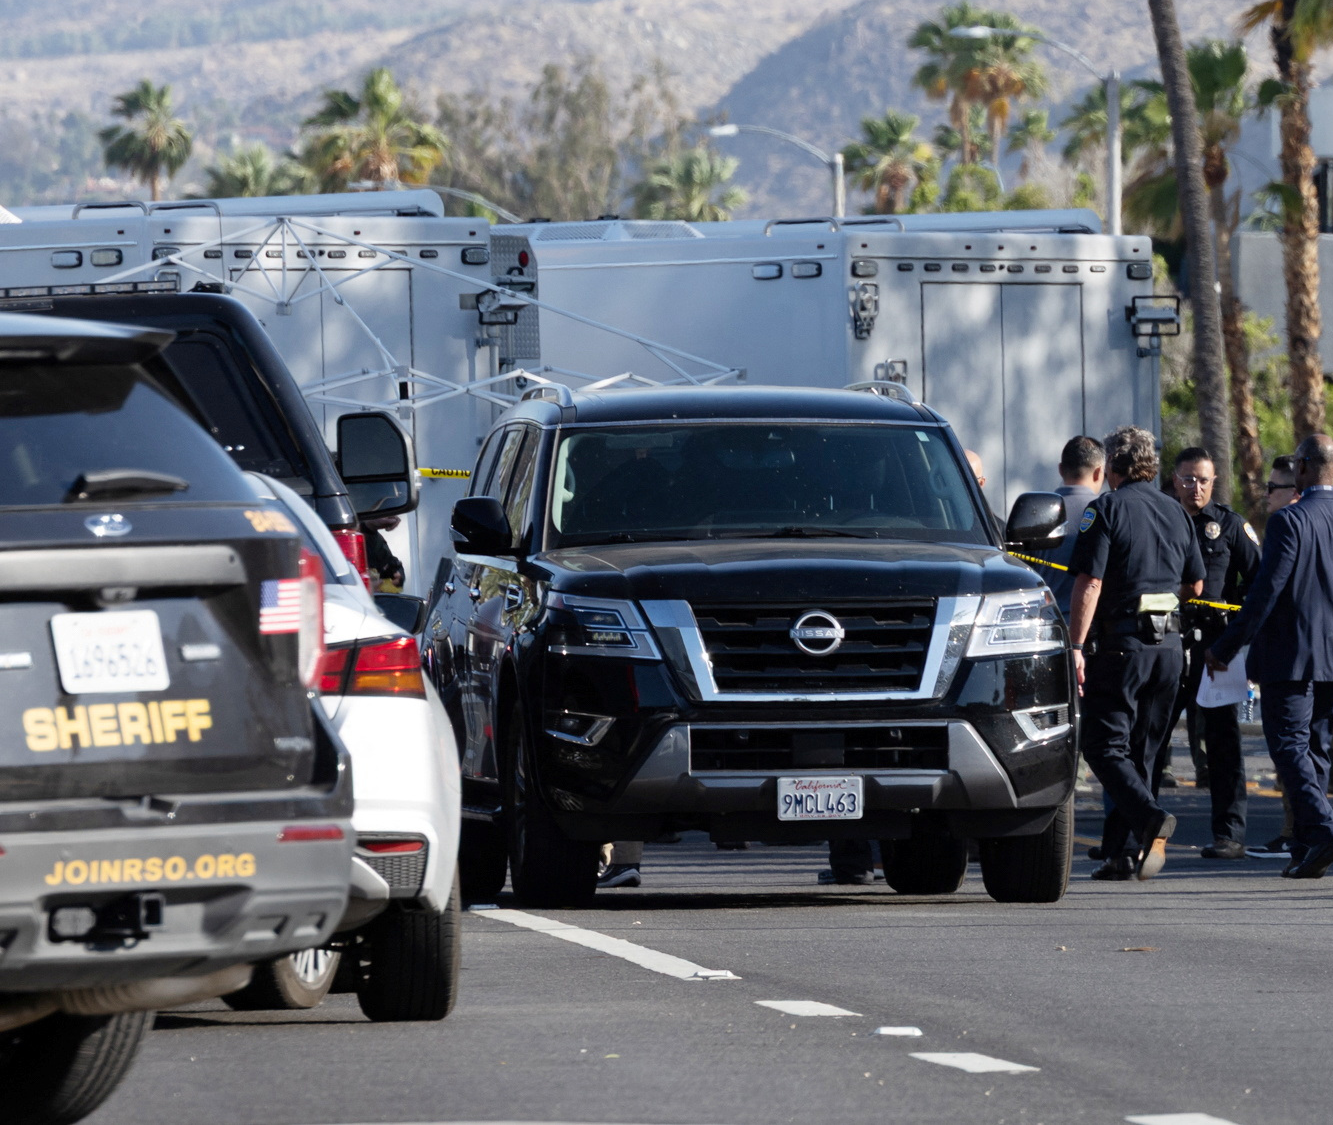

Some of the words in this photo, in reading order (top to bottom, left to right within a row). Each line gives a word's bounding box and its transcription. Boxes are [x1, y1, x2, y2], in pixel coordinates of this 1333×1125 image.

[791, 629, 843, 637] NISSAN
[69, 642, 157, 679] 1696526
[23, 699, 212, 752] SHERIFF
[795, 780, 847, 793] California
[783, 793, 857, 814] 9MCL463
[45, 852, 257, 886] JOINRSO.ORG
